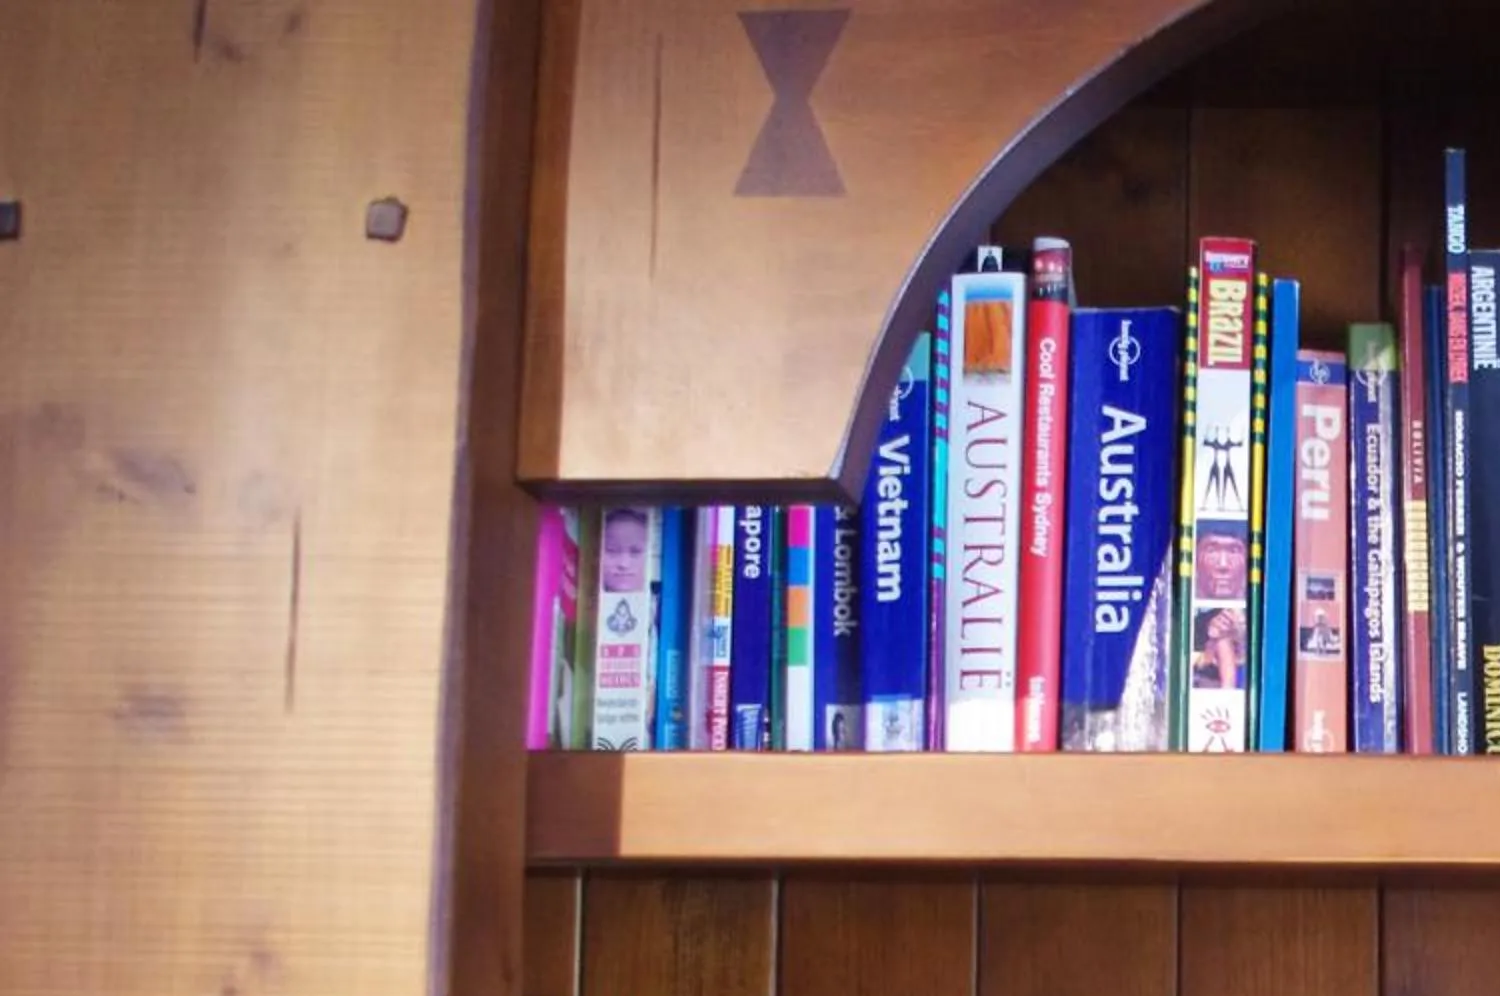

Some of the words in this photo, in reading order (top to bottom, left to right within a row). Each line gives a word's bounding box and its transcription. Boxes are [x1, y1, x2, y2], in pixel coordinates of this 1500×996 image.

[1039, 337, 1056, 379] Cool
[1035, 382, 1055, 487] Restaurants
[1300, 403, 1342, 522] Peru
[1365, 424, 1383, 495] Ecuador
[876, 434, 911, 603] Vietnam
[959, 400, 1012, 690] AUSTRALIË
[1031, 491, 1052, 558] Sydney
[1096, 405, 1148, 635] Australia
[834, 528, 858, 637] Lombok
[1368, 643, 1385, 704] Islands
